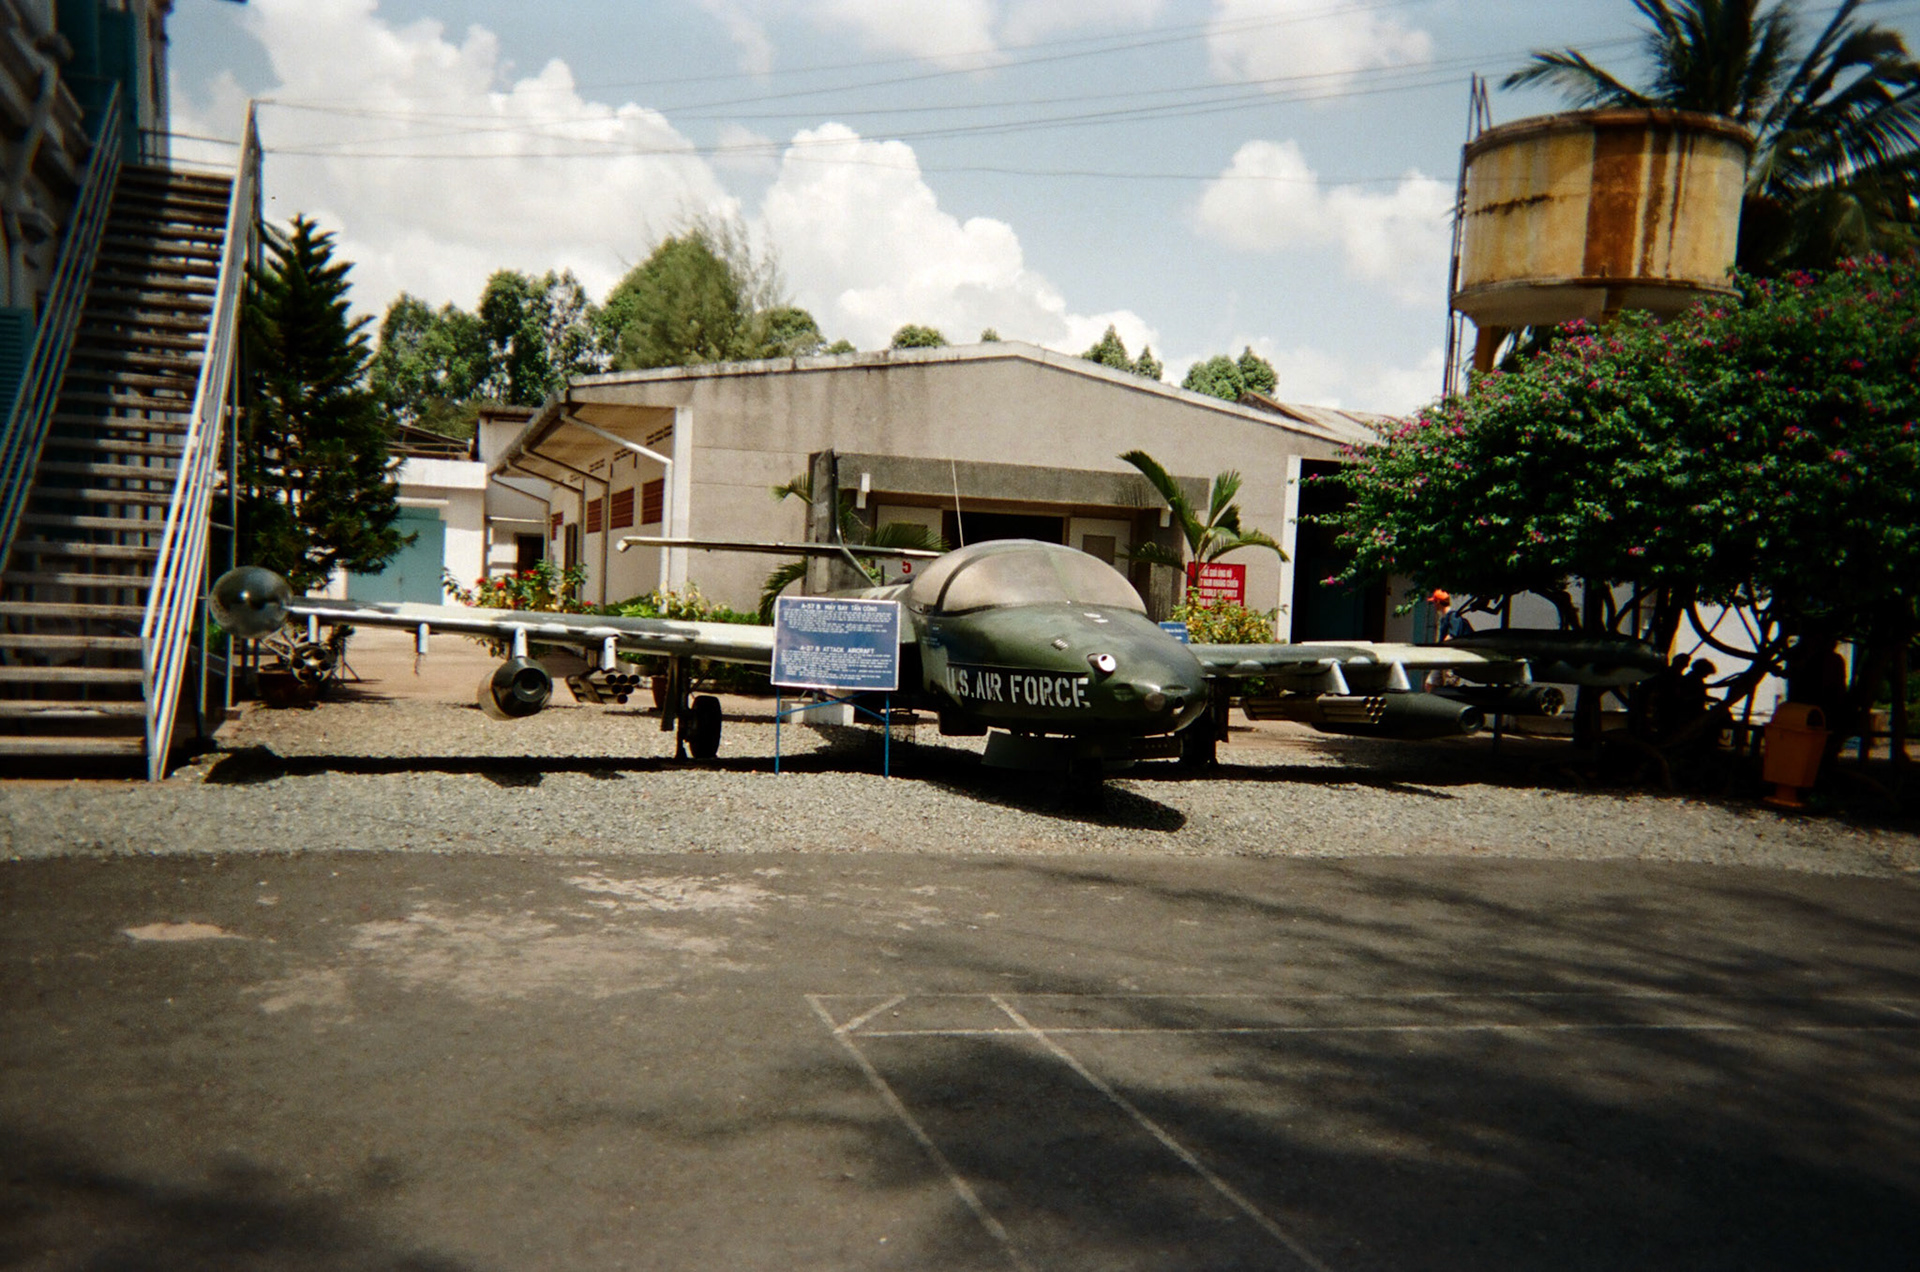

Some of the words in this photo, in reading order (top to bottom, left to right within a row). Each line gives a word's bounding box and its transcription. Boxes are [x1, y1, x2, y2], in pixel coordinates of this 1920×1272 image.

[902, 560, 912, 574] 5
[847, 647, 875, 655] AIRCRAFT
[1010, 674, 1092, 709] FORCE
